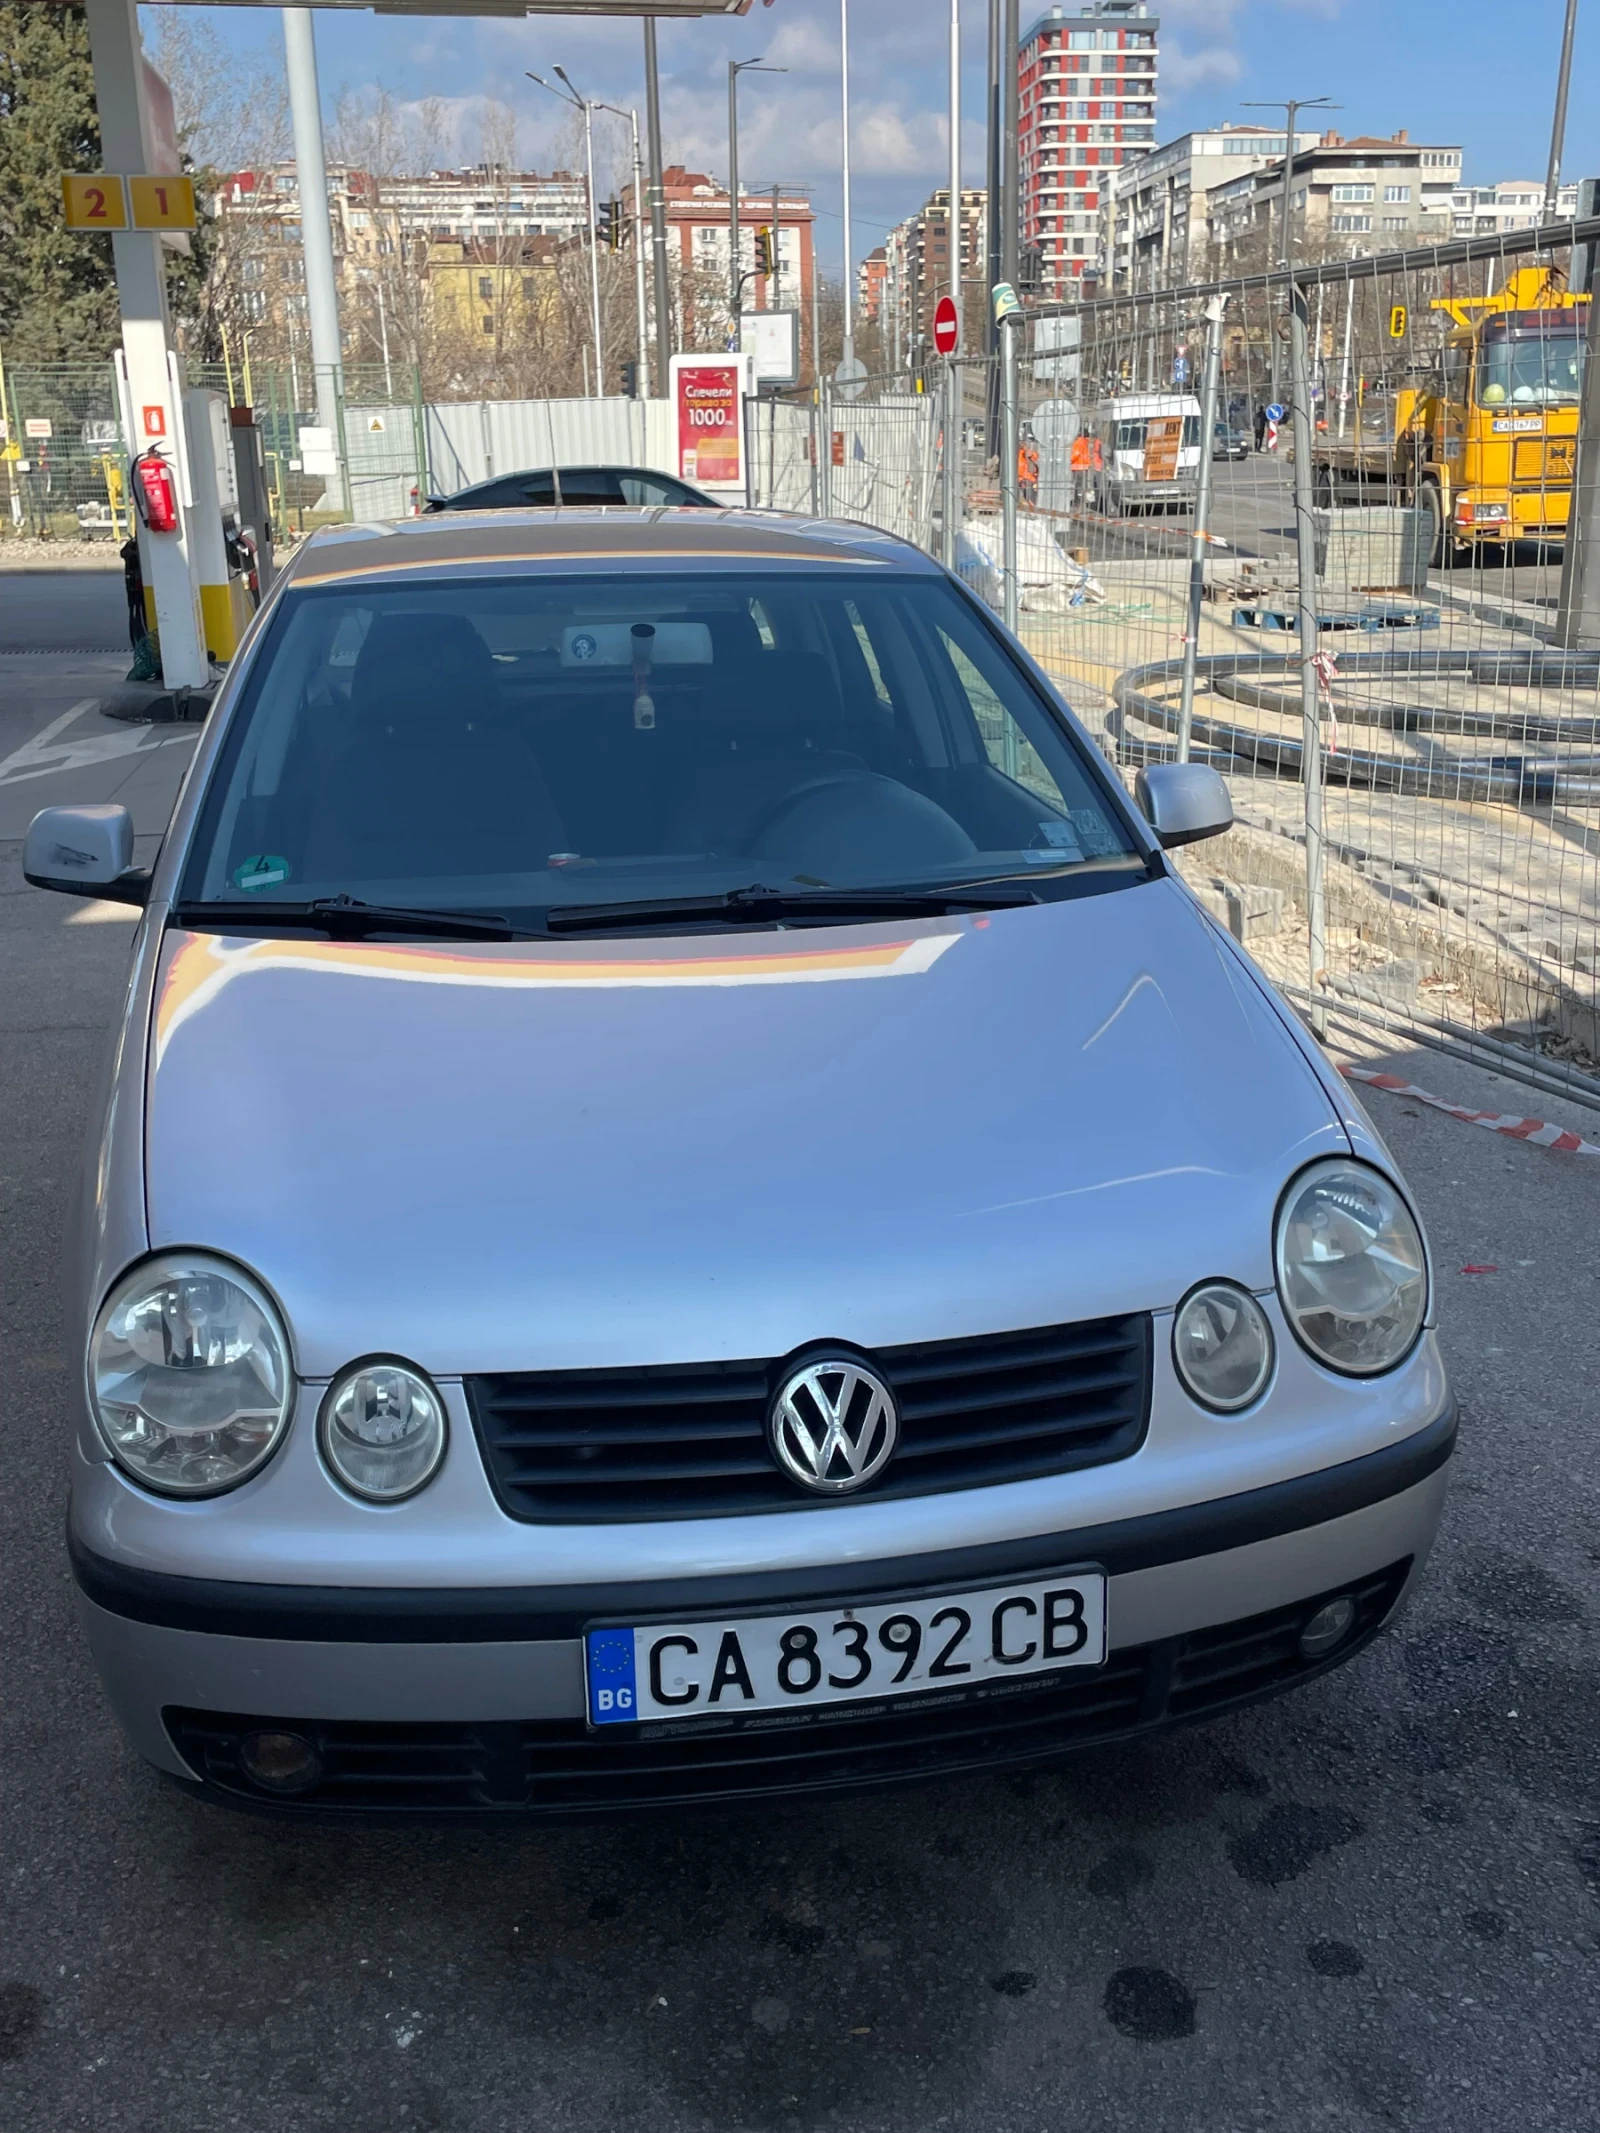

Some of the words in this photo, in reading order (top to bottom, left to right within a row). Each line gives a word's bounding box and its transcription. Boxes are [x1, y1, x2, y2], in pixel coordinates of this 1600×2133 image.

[84, 188, 107, 217] 2
[154, 187, 168, 215] 1
[685, 385, 732, 397] Спечели
[689, 409, 725, 425] 1000
[255, 856, 270, 872] 4
[649, 1630, 756, 1706] CA
[777, 1606, 972, 1694] 8392
[991, 1588, 1089, 1665] CB
[598, 1688, 632, 1711] BG
